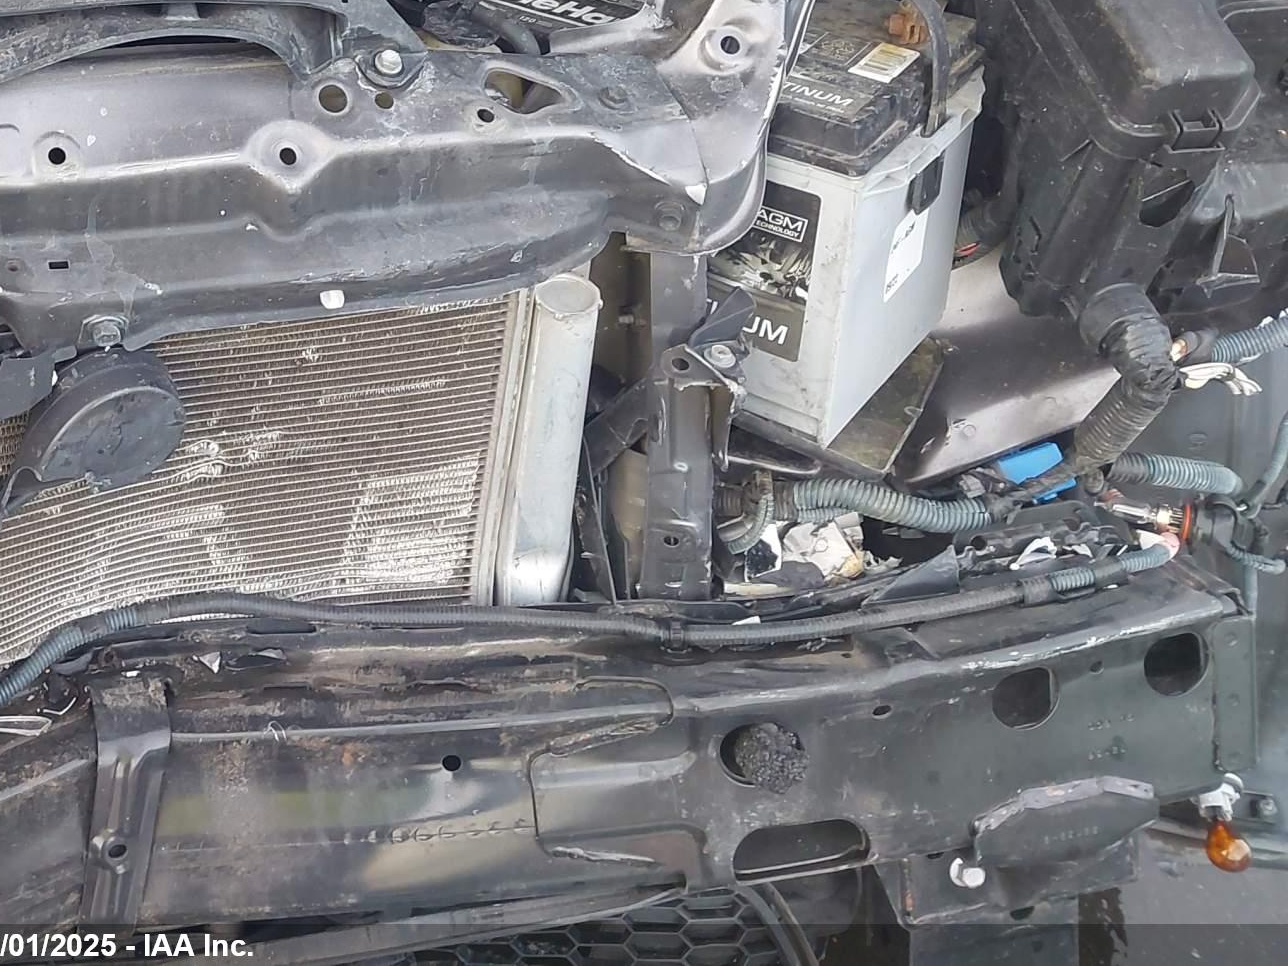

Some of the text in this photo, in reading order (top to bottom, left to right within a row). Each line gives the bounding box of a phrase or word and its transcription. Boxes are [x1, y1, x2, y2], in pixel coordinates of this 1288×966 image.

[782, 81, 854, 107] TINUM
[756, 219, 800, 238] ECHNOLOGY
[757, 209, 803, 232] AGM
